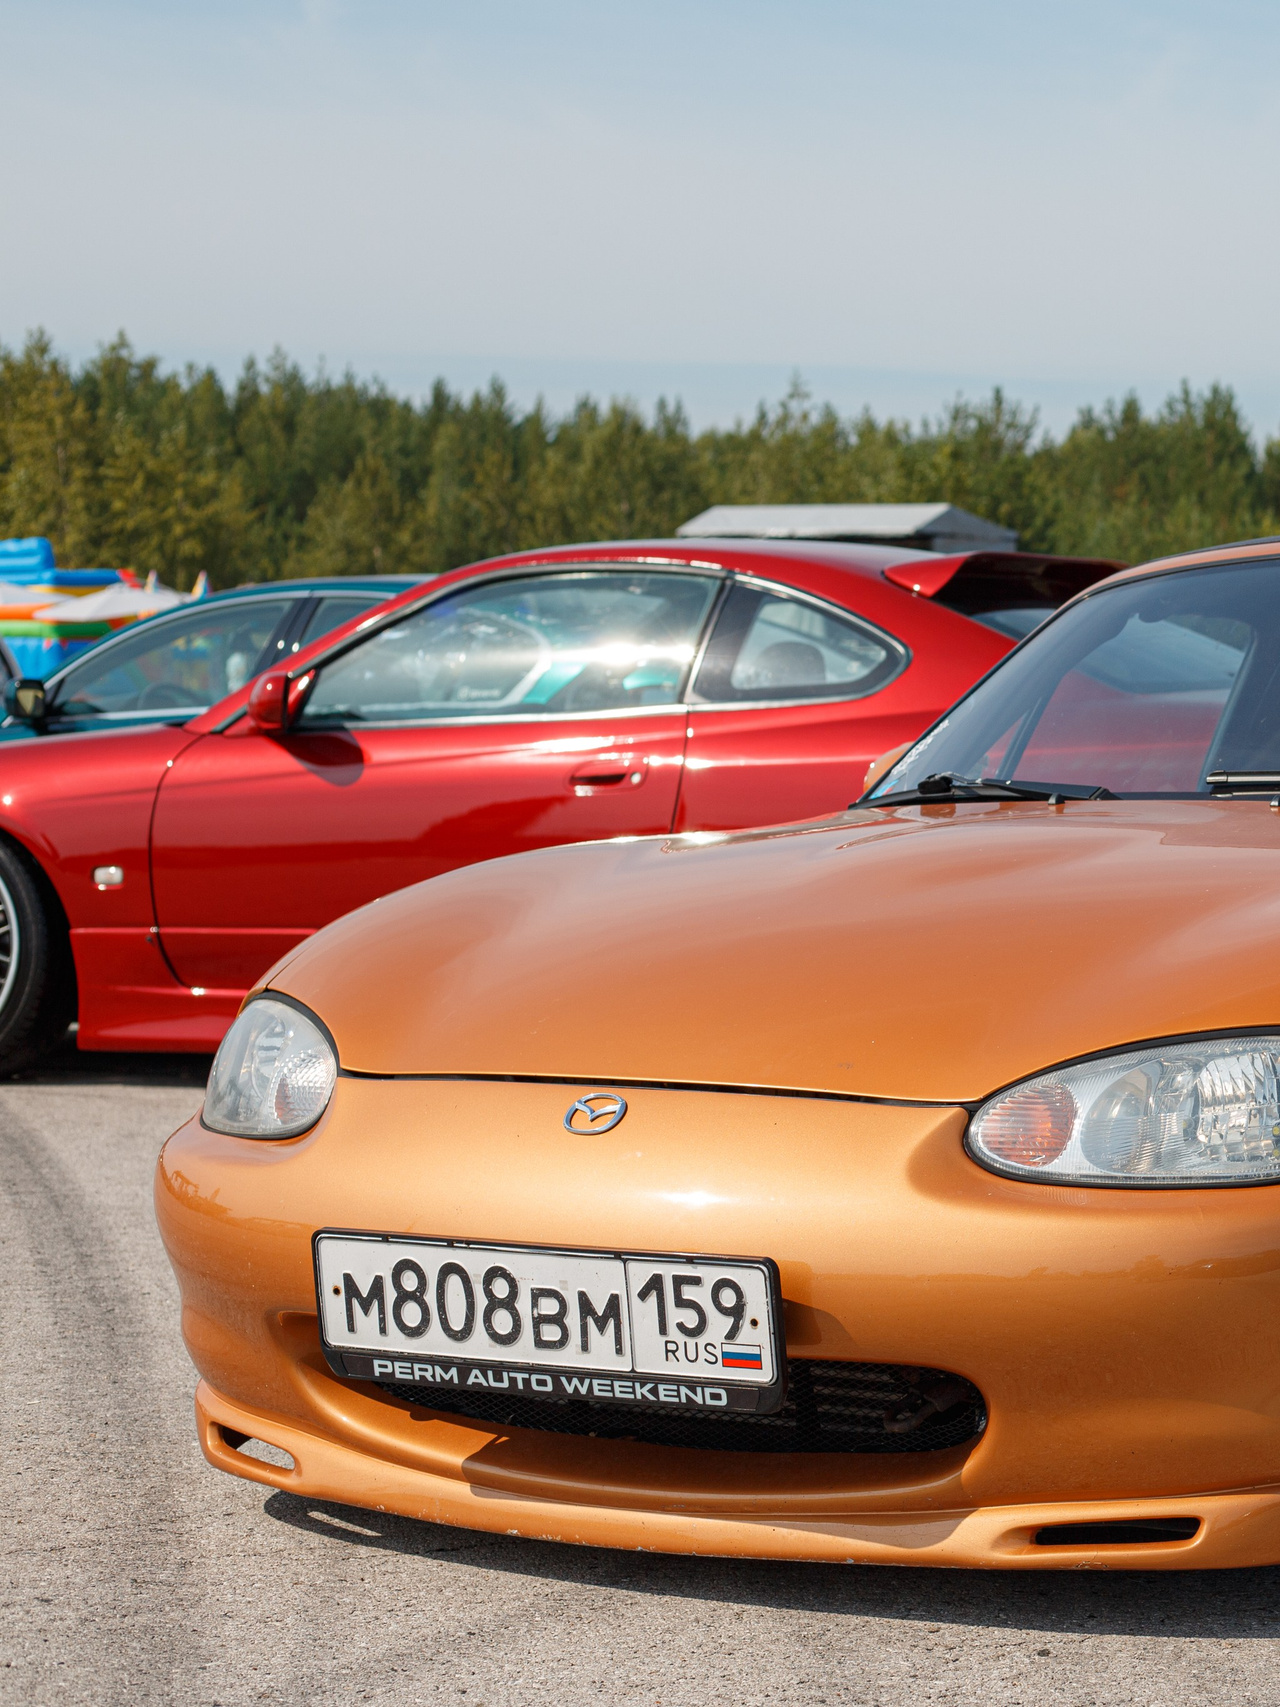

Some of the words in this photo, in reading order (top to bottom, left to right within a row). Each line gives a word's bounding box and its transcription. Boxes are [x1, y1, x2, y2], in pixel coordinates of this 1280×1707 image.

[637, 1272, 746, 1341] 159
[664, 1340, 719, 1365] RUS
[373, 1358, 460, 1385] PERM
[466, 1370, 554, 1393] AUTO
[560, 1376, 729, 1407] WEEKEND
